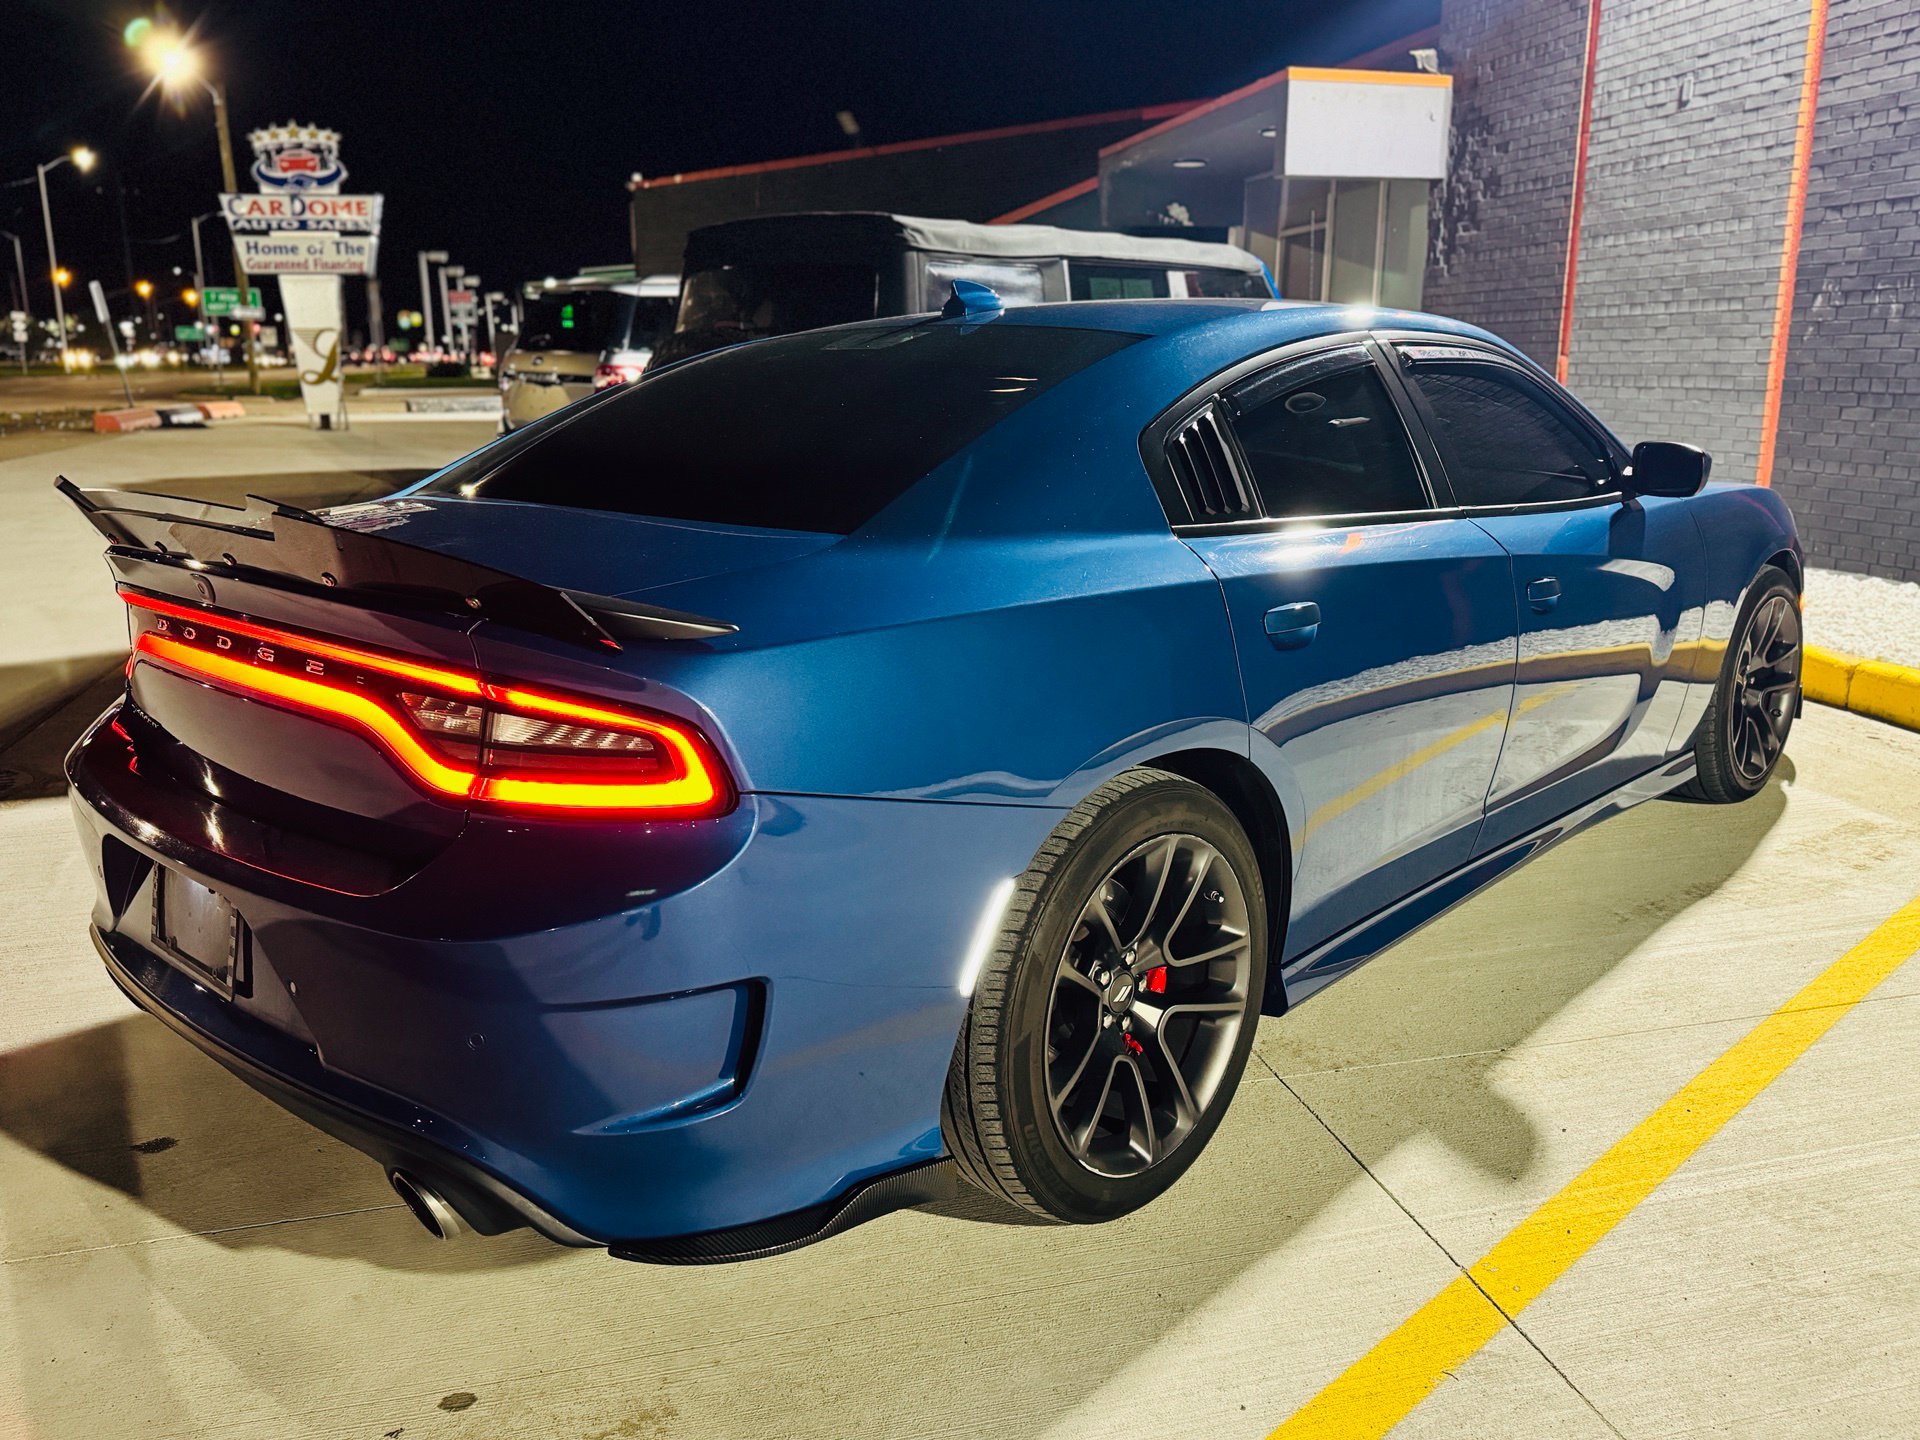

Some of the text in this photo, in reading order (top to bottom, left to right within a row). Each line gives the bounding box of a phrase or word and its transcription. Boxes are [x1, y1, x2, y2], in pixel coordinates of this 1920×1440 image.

[234, 218, 370, 230] AUTO SALES
[246, 241, 299, 255] Home
[334, 240, 365, 255] The
[246, 258, 364, 272] Guaranteed Financing
[157, 617, 325, 676] DODGE
